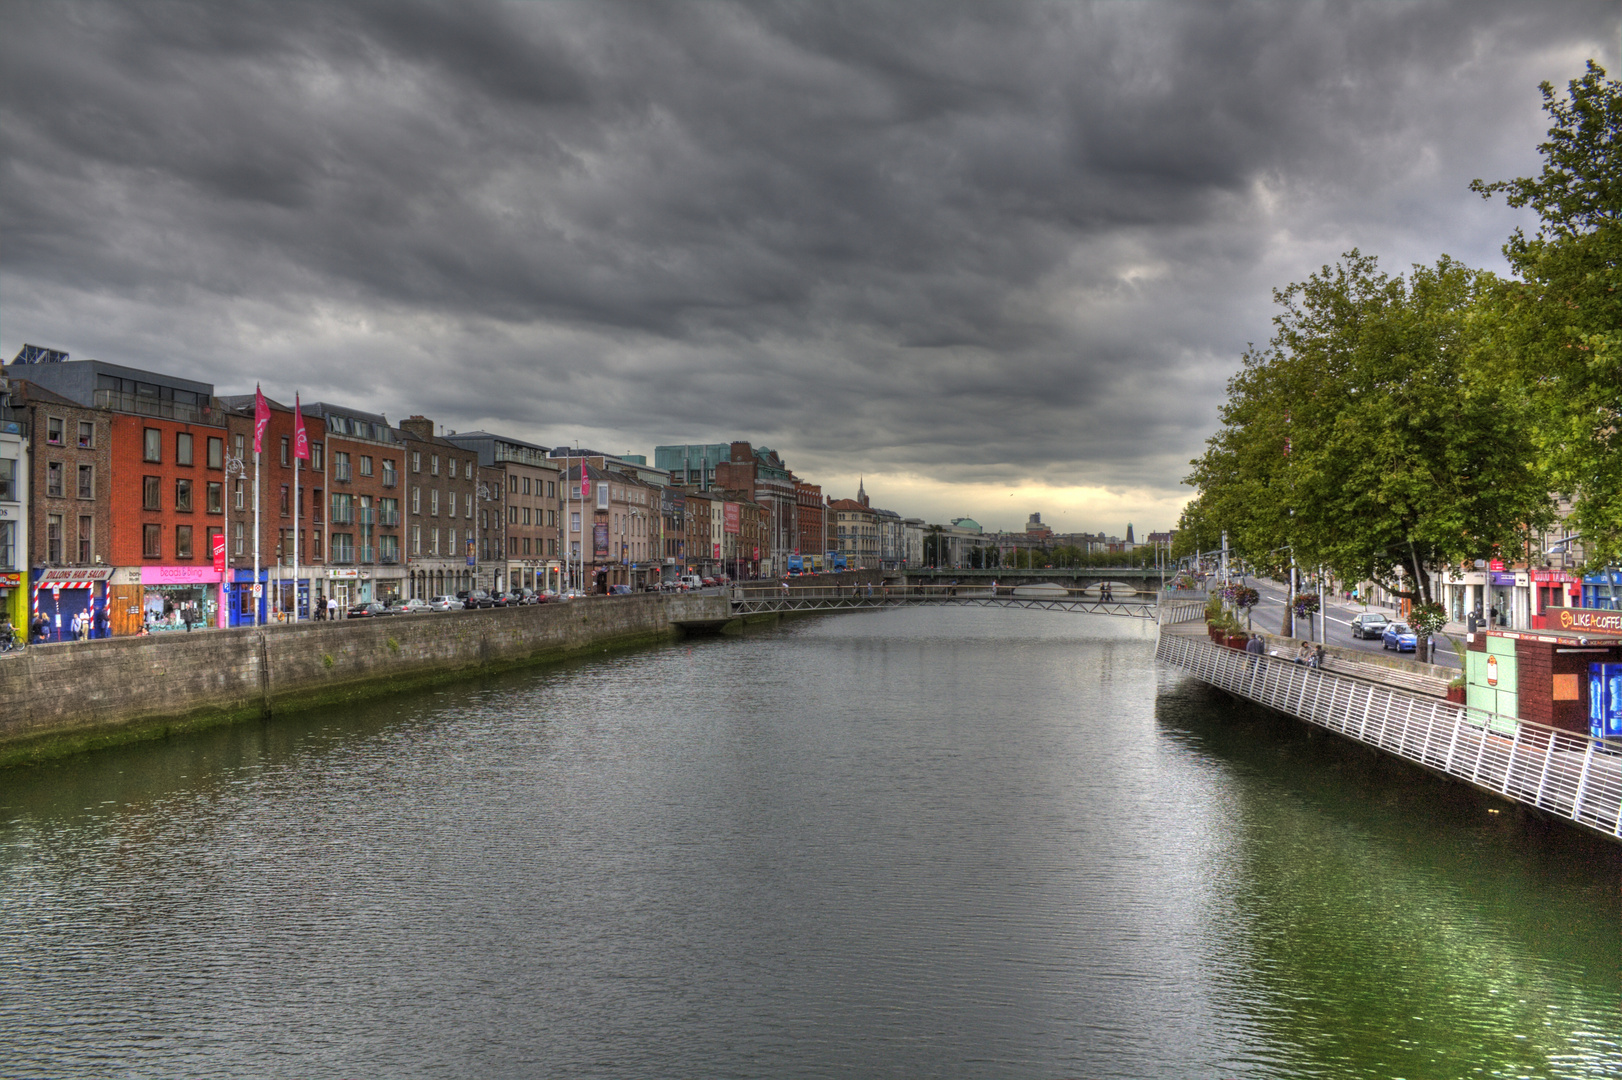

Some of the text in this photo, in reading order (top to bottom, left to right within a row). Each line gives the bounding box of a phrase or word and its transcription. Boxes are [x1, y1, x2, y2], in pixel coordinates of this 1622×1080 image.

[46, 570, 108, 579] DILLONS HAIR SALON
